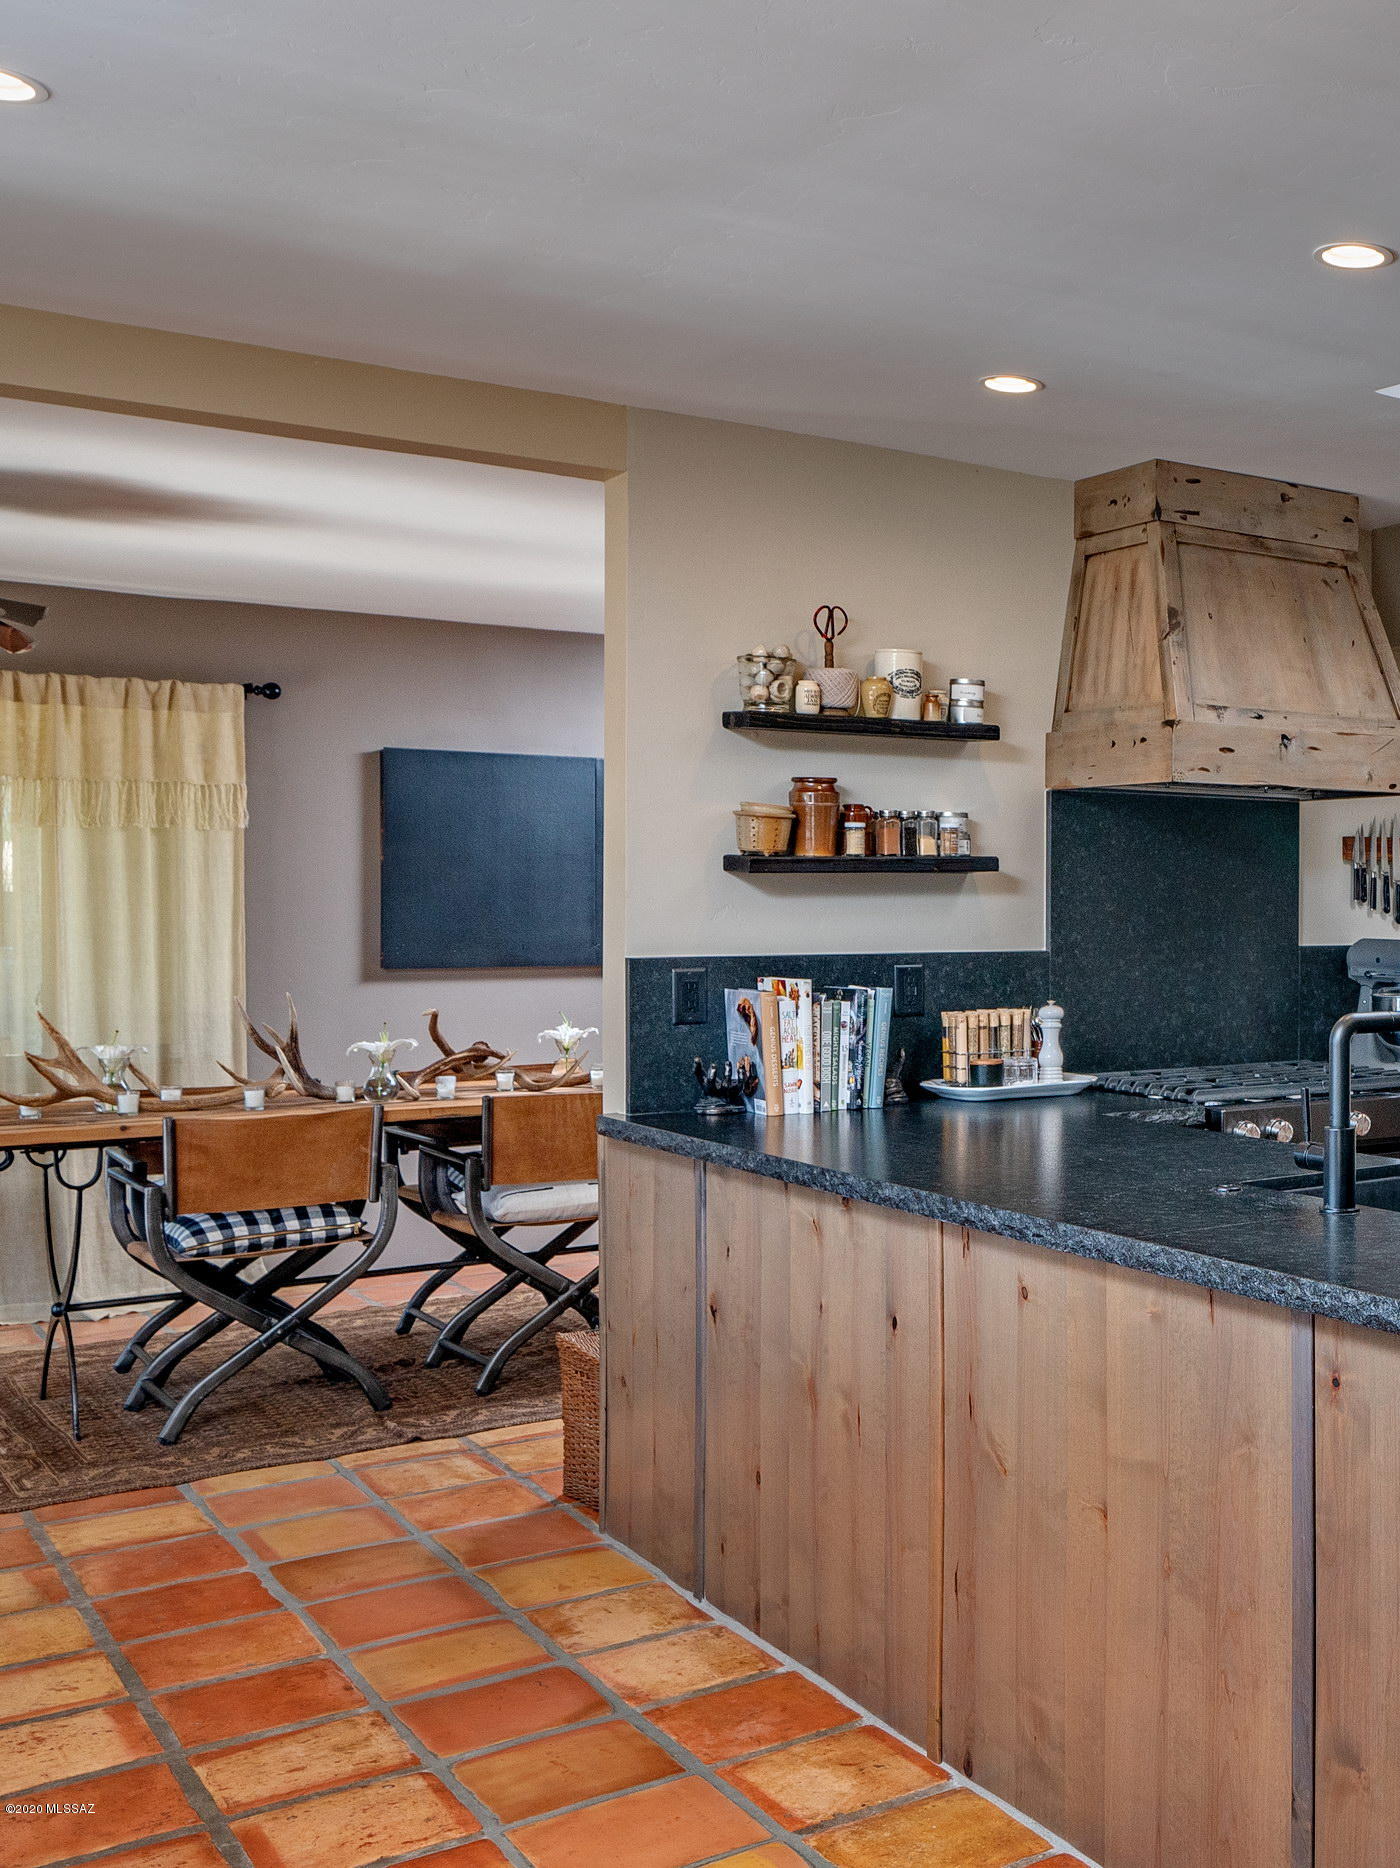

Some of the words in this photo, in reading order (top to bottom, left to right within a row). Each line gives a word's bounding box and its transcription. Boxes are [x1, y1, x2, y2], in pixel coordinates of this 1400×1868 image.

[782, 1010, 797, 1019] SALT
[784, 1019, 795, 1027] FAT
[769, 1026, 777, 1052] GENIUS
[782, 1035, 797, 1043] HEAT
[822, 1030, 832, 1046] ONE
[832, 1027, 840, 1056] MIGHTY
[821, 1046, 831, 1066] GOOD
[864, 1042, 872, 1068] VEGAN
[771, 1053, 779, 1087] DESSERTS
[821, 1067, 831, 1083] DISH
[831, 1057, 839, 1085] SALADS
